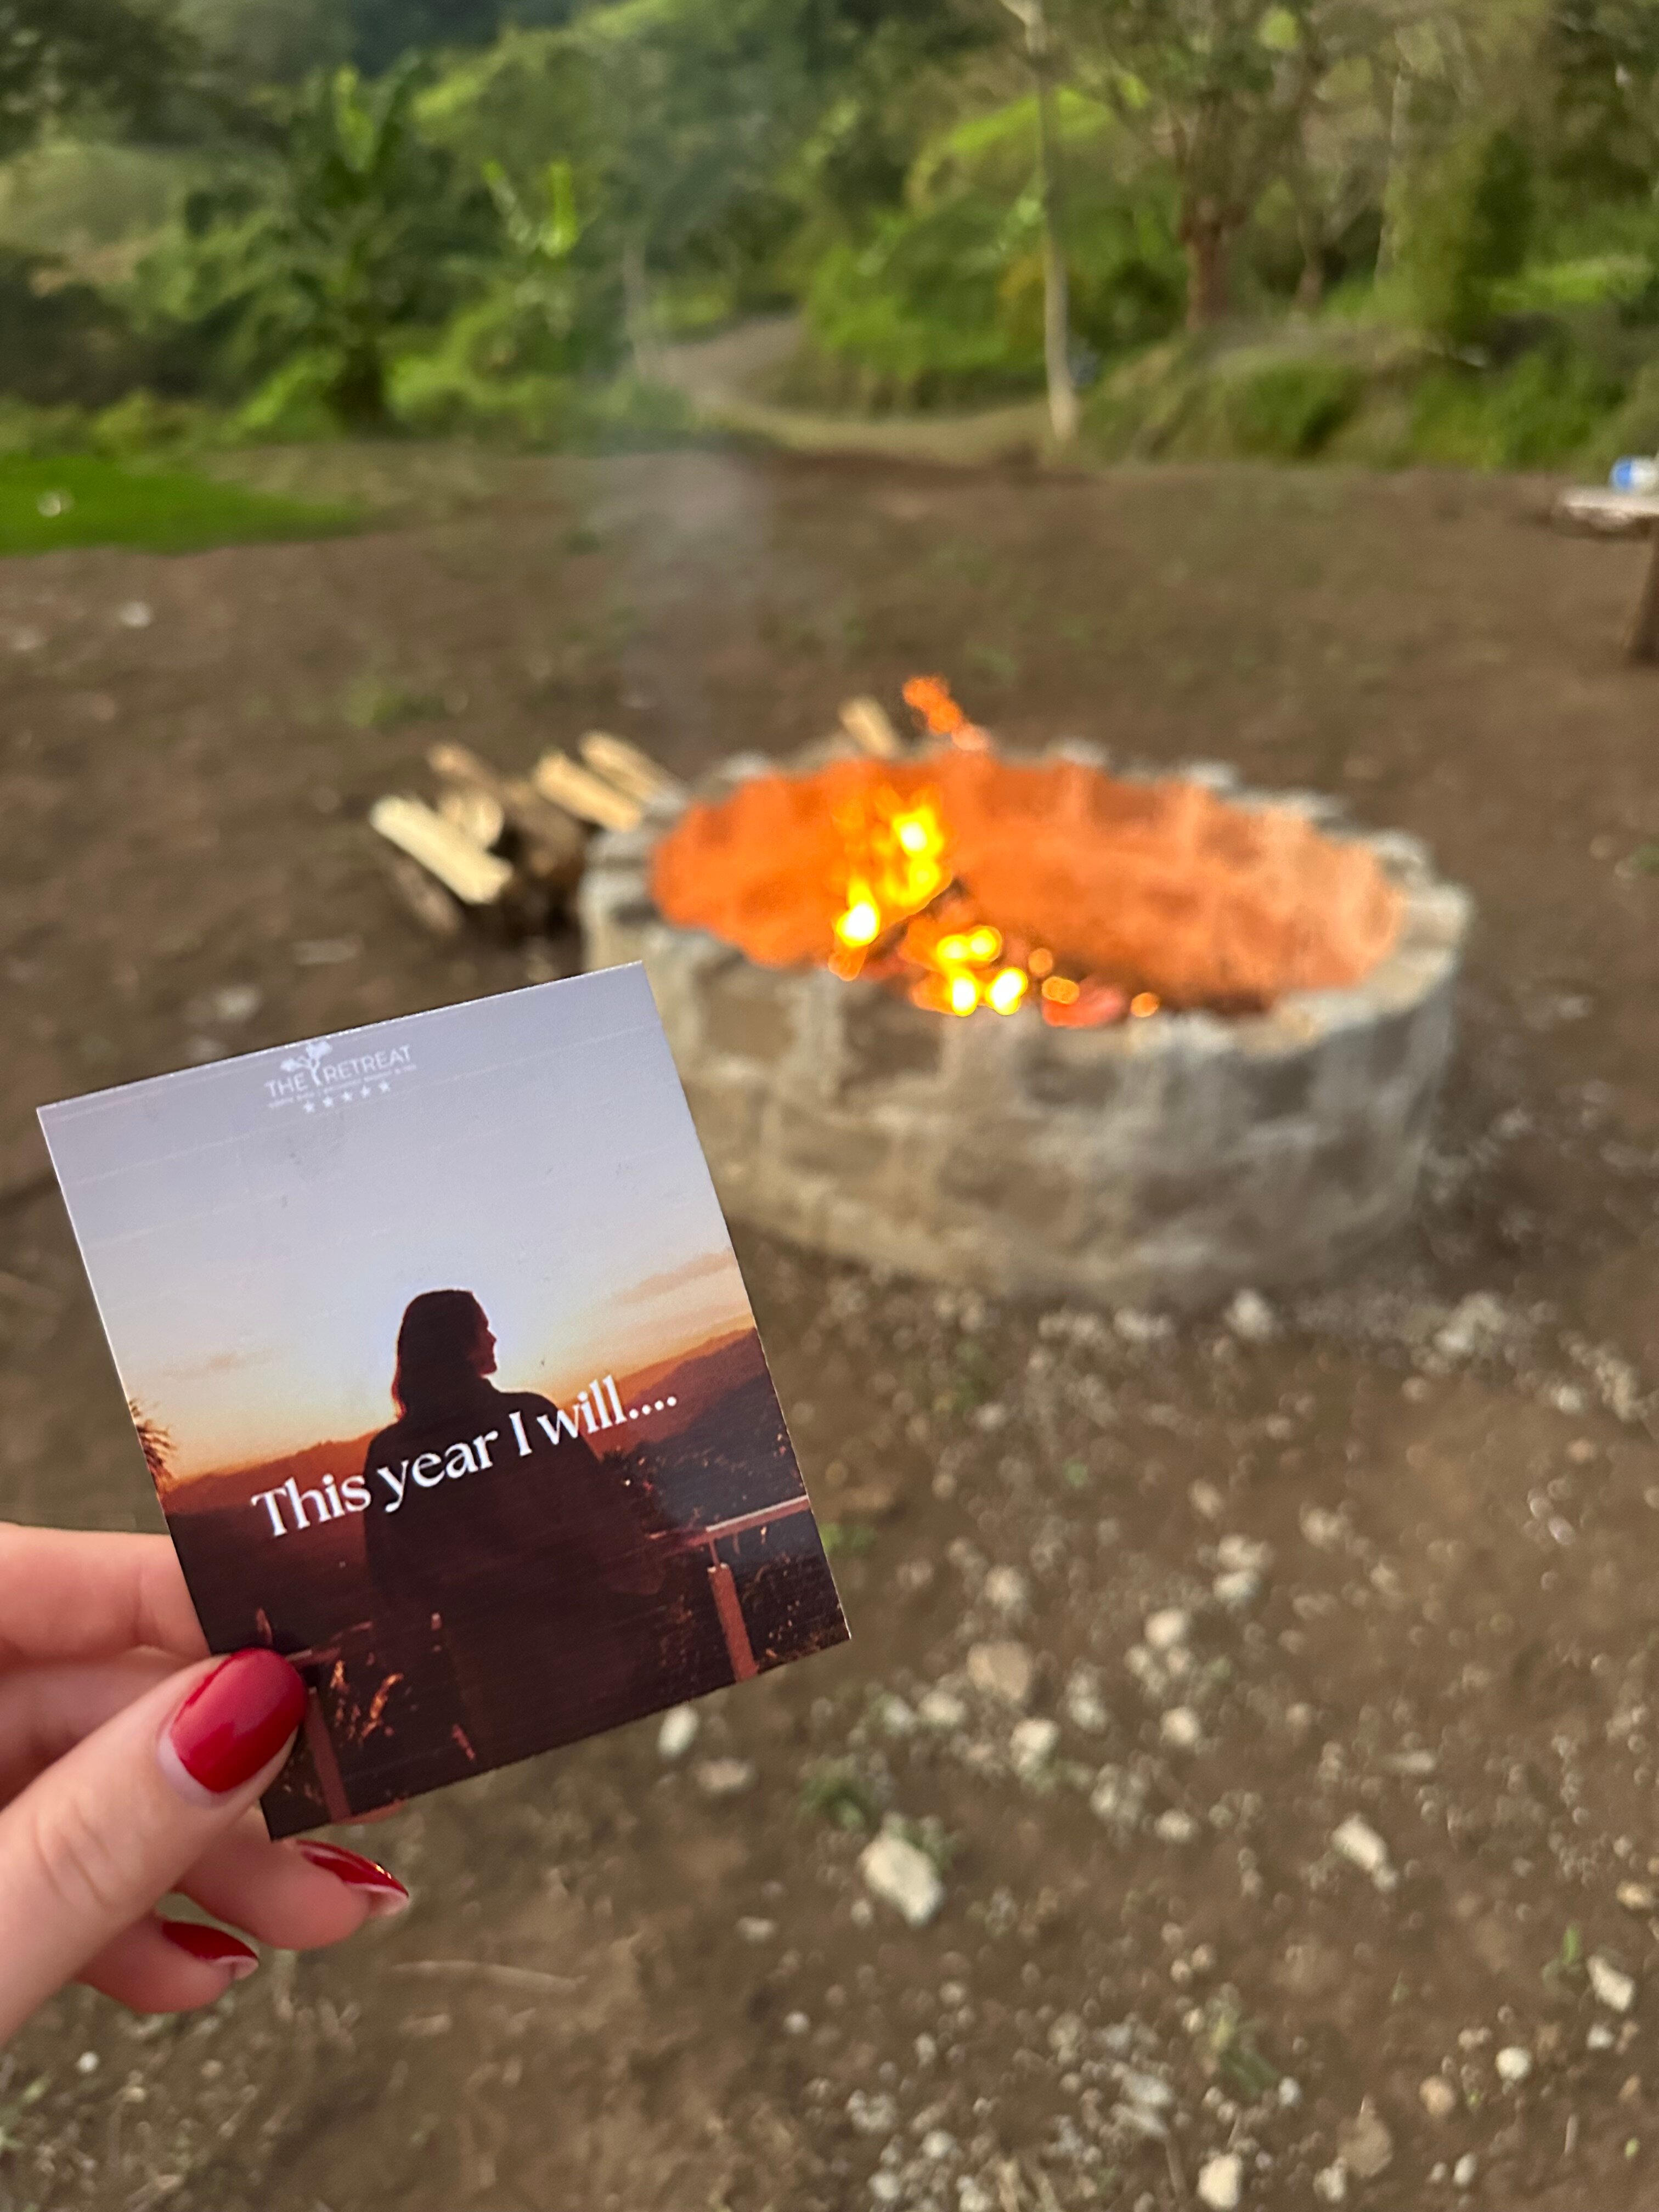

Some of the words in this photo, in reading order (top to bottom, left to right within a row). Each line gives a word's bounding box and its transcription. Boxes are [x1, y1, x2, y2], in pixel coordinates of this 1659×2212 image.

[264, 1073, 308, 1097] THE
[323, 1044, 410, 1084] RETREAT
[251, 1474, 372, 1537] This
[377, 1429, 498, 1513] year
[509, 1412, 532, 1457] I
[537, 1375, 677, 1446] will....
